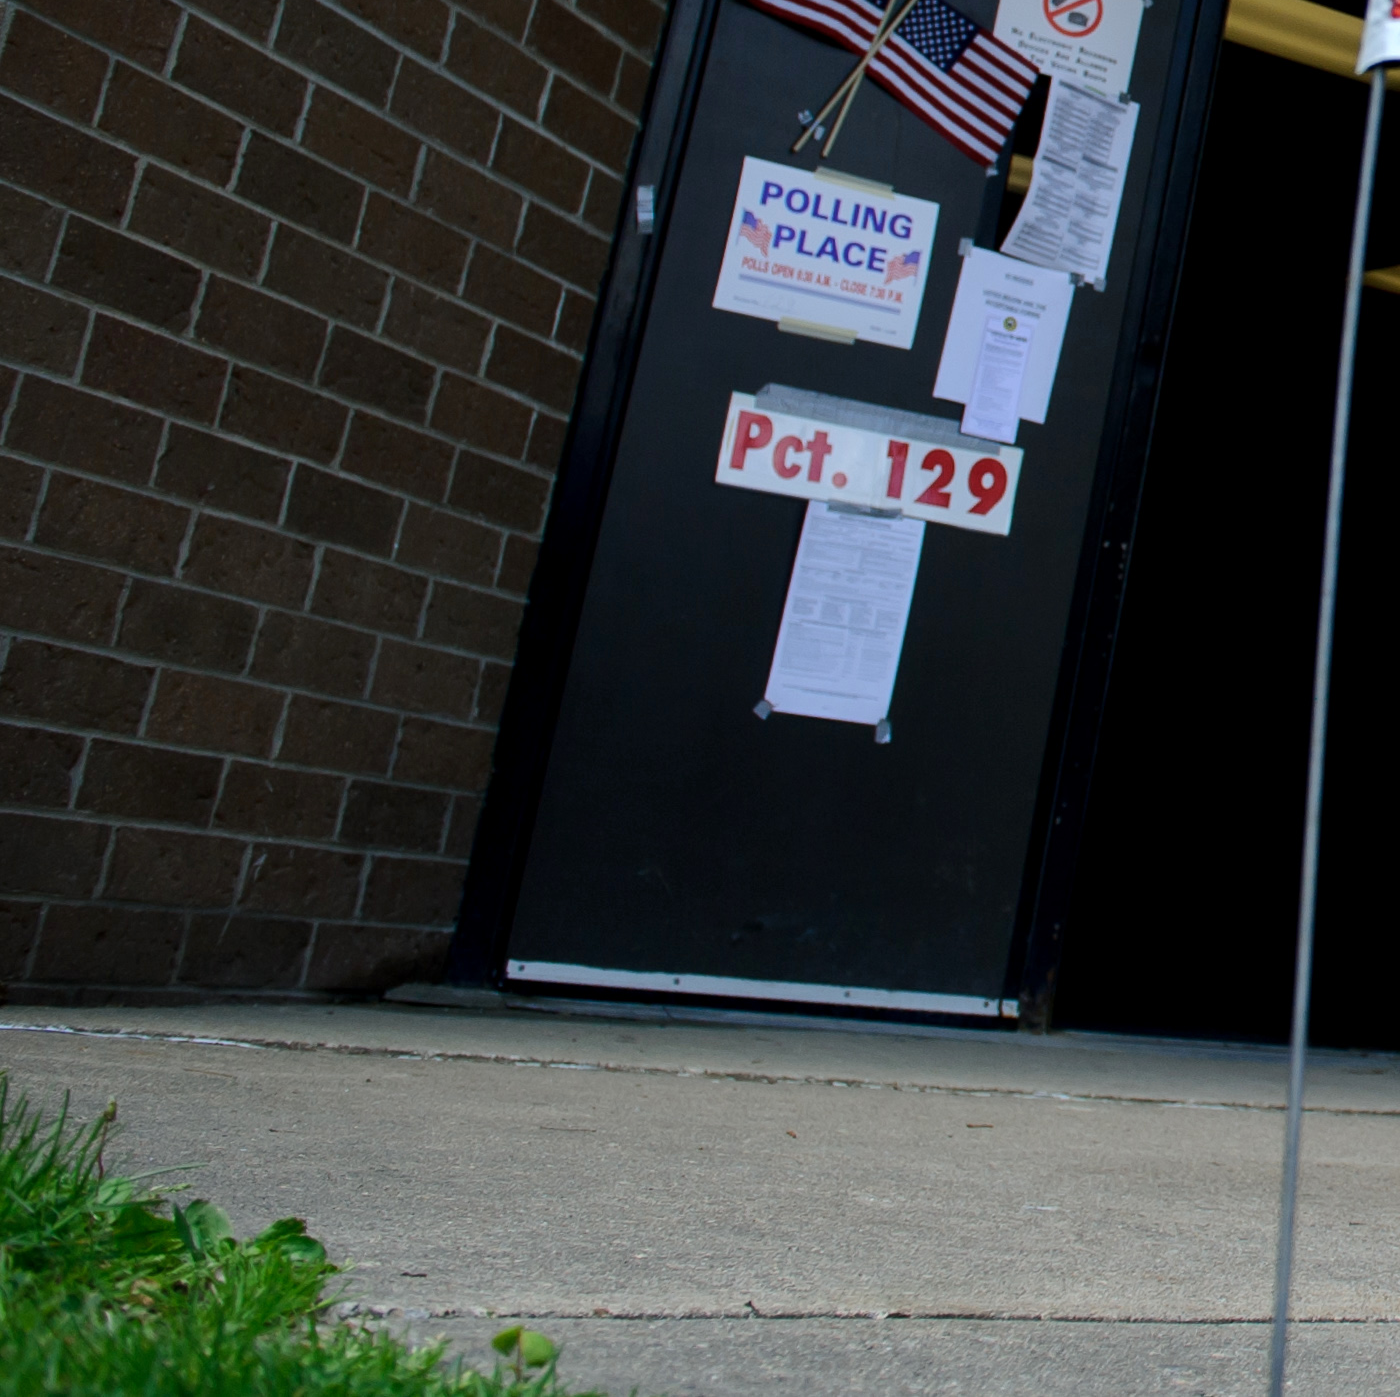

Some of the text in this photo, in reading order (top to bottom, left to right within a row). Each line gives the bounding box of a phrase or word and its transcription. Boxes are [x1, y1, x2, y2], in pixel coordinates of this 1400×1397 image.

[759, 180, 914, 240] POLLING
[742, 256, 769, 274] POLLS
[771, 263, 794, 279] OPEN
[840, 279, 867, 296] CLOSE
[772, 224, 888, 274] PLACE
[730, 409, 1008, 517] Pct. 129
